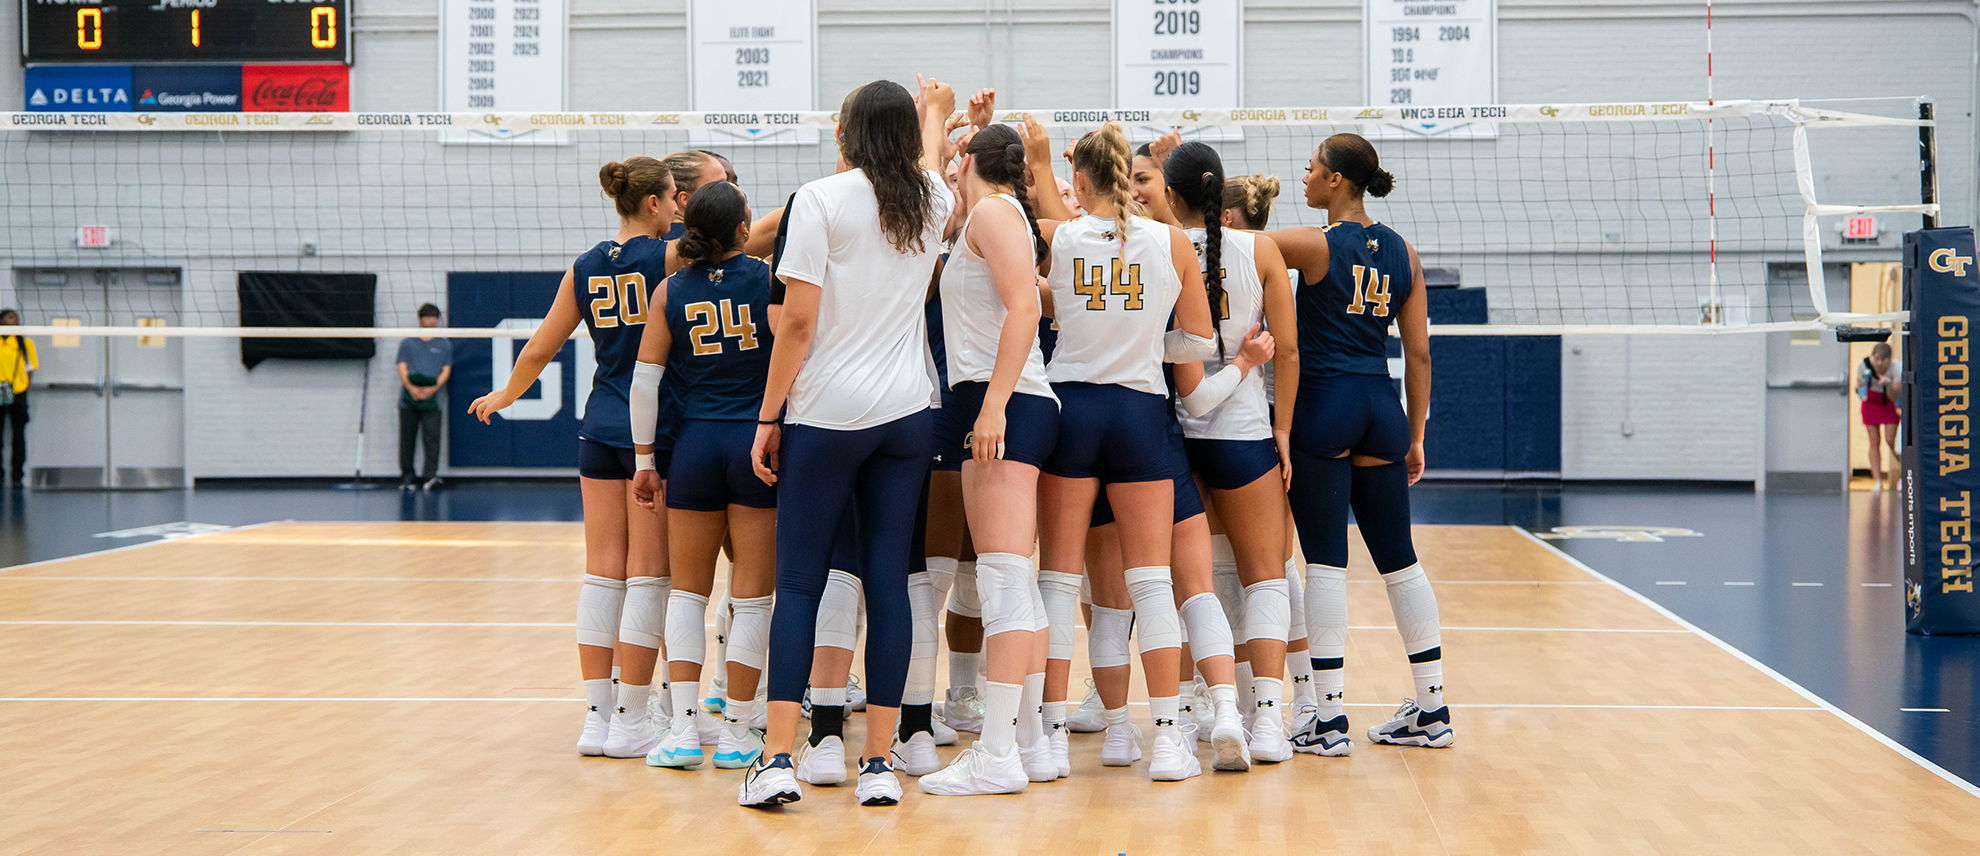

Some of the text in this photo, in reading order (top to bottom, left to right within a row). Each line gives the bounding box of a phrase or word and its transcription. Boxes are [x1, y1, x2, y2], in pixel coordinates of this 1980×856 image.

[1404, 4, 1457, 16] CHAMPIONS
[77, 8, 102, 50] 0
[191, 9, 200, 48] 1
[311, 6, 337, 49] 0
[1154, 10, 1200, 35] 2019
[1392, 26, 1470, 42] 1994 2004
[736, 48, 770, 64] 2003
[1151, 49, 1203, 60] CHAMPIONS
[738, 70, 769, 86] 2021
[1154, 71, 1200, 95] 2019
[53, 88, 128, 104] DELTA
[158, 91, 238, 108] Georgia Power
[653, 114, 680, 122] ACC
[1003, 112, 1024, 120] AC
[1054, 110, 1150, 122] GEORGIA TECH
[1231, 109, 1327, 121] GEORGIA TECH
[1357, 108, 1385, 117] ACC
[1471, 107, 1506, 118] TECH
[1589, 104, 1688, 116] GEORGIA TECH
[12, 114, 107, 125] GEORGIA TECH
[185, 114, 279, 125] GEORGIA TECH
[357, 114, 452, 125] GEORGIA TECH
[530, 114, 625, 125] GEORGIA TECH
[704, 113, 799, 125] GEORGIA TECH
[1848, 217, 1873, 238] EXIT
[1073, 257, 1144, 311] 44
[1346, 265, 1391, 317] 14
[588, 272, 649, 328] 20
[684, 299, 759, 355] 24
[1938, 315, 1971, 476] GEORGIA
[1906, 469, 1916, 566] sports imports
[1939, 491, 1973, 594] TECH
